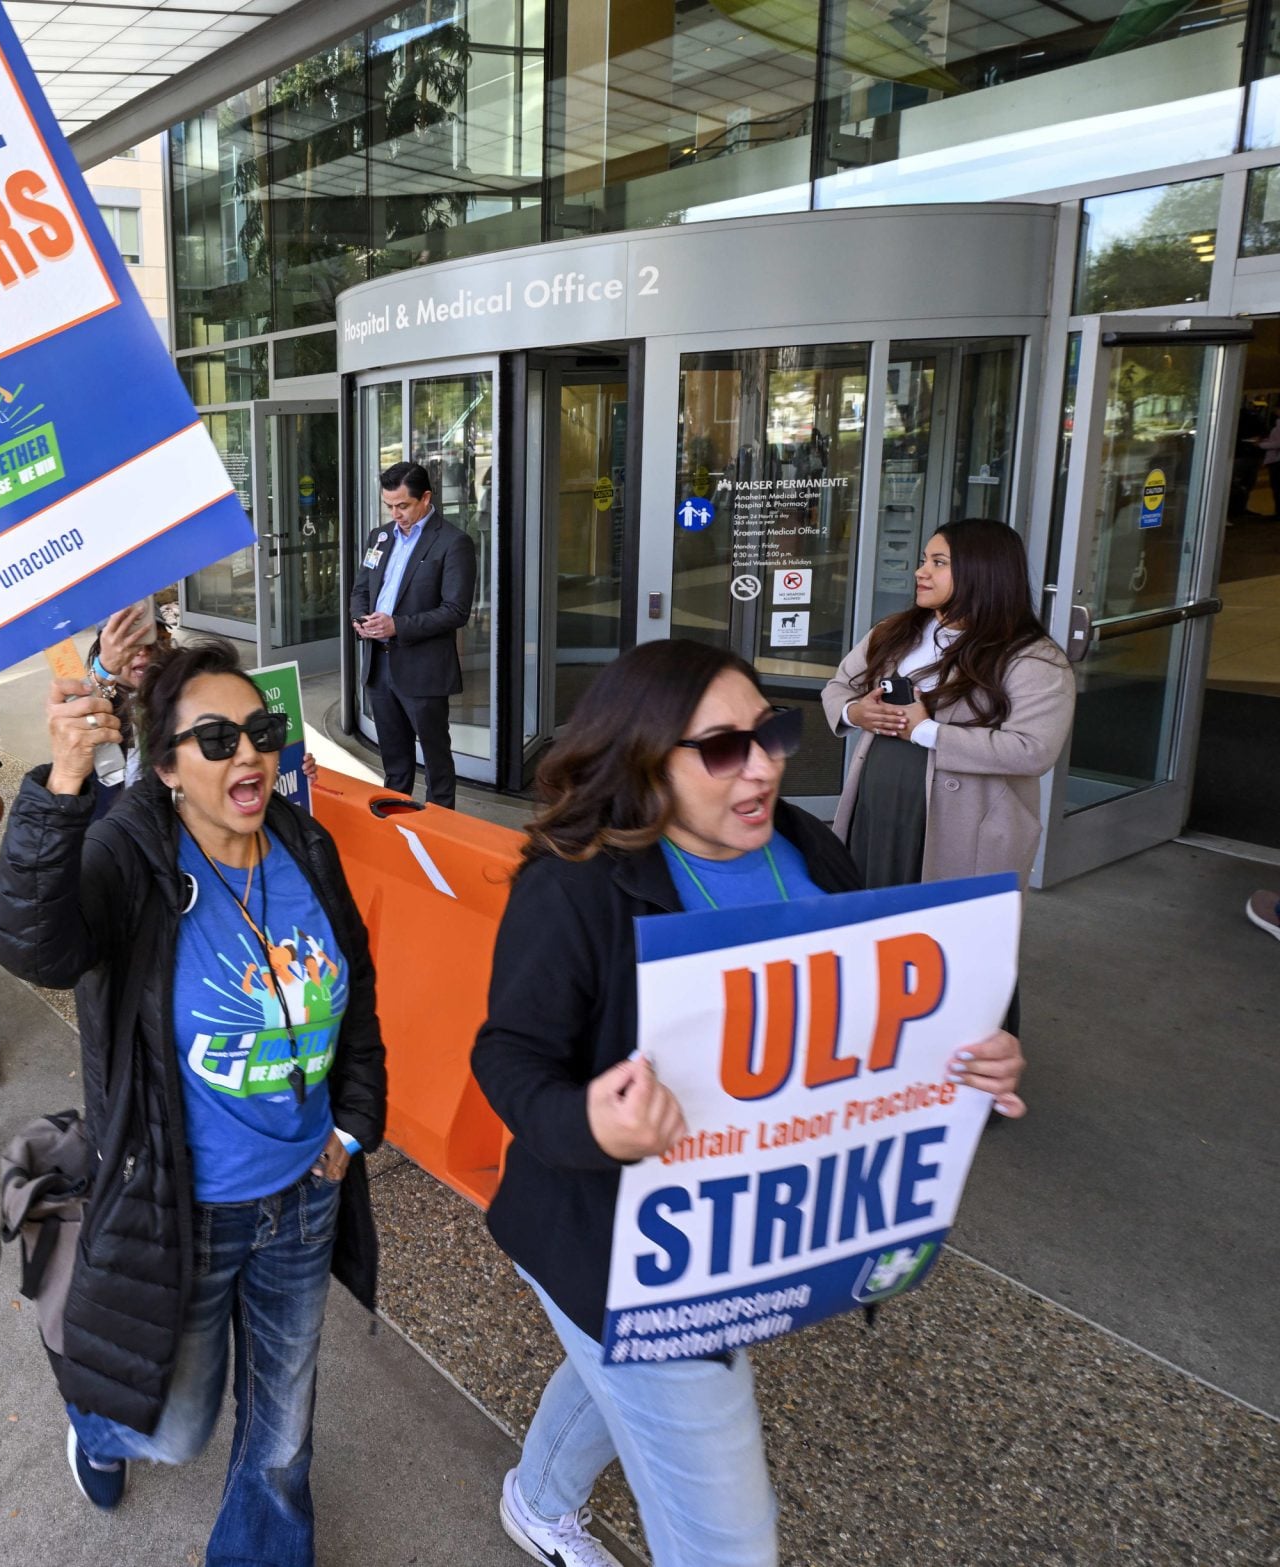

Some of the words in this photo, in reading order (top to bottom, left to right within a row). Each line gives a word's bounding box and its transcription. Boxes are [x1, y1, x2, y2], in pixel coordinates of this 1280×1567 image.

[344, 305, 389, 344] Hospital
[396, 304, 410, 330] &
[416, 281, 512, 327] Medical
[524, 272, 624, 308] Office
[638, 265, 660, 296] 2
[18, 466, 38, 485] WE
[34, 456, 57, 477] WIN
[735, 480, 772, 490] KAISER
[776, 478, 849, 489] PERMANENTE
[734, 501, 764, 510] Hospital
[733, 529, 765, 537] Kraemer
[767, 527, 796, 535] Medical
[798, 527, 820, 535] Office
[264, 687, 281, 701] ND
[720, 932, 947, 1102] ULP
[248, 1065, 269, 1082] WE
[757, 1109, 837, 1150] Labor
[843, 1081, 958, 1130] Practice
[635, 1125, 947, 1288] STRIKE
[611, 1313, 794, 1364] #TogetherWeWin
